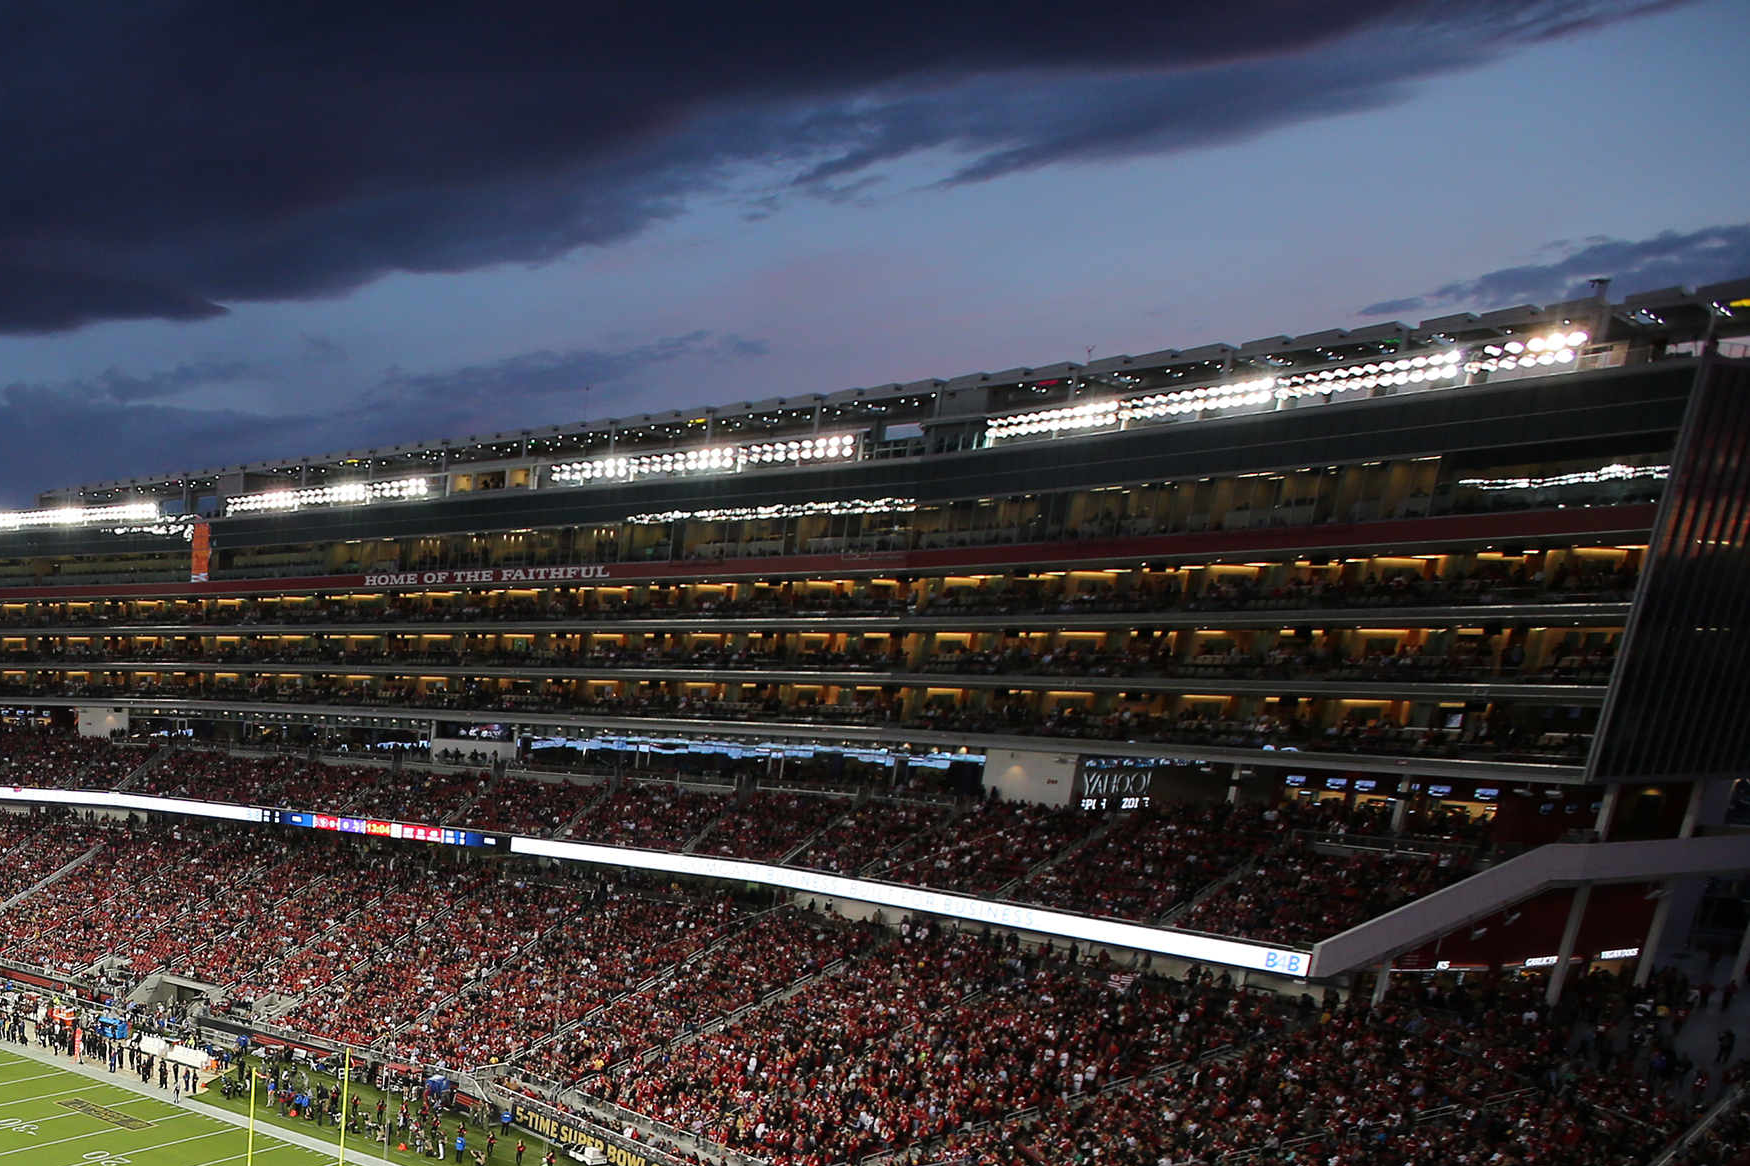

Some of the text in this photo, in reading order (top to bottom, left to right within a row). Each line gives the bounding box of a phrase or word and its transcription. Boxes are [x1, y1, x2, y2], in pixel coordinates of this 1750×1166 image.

[364, 566, 610, 586] HOME OF THE FAITHFUL
[1083, 771, 1153, 796] YAHOO!
[367, 822, 390, 835] 13:04
[849, 882, 895, 902] BUILT
[900, 890, 936, 908] FOR
[943, 897, 1039, 928] BUSINESS.
[1264, 950, 1301, 973] B4B
[515, 1105, 559, 1138] 5-TIME
